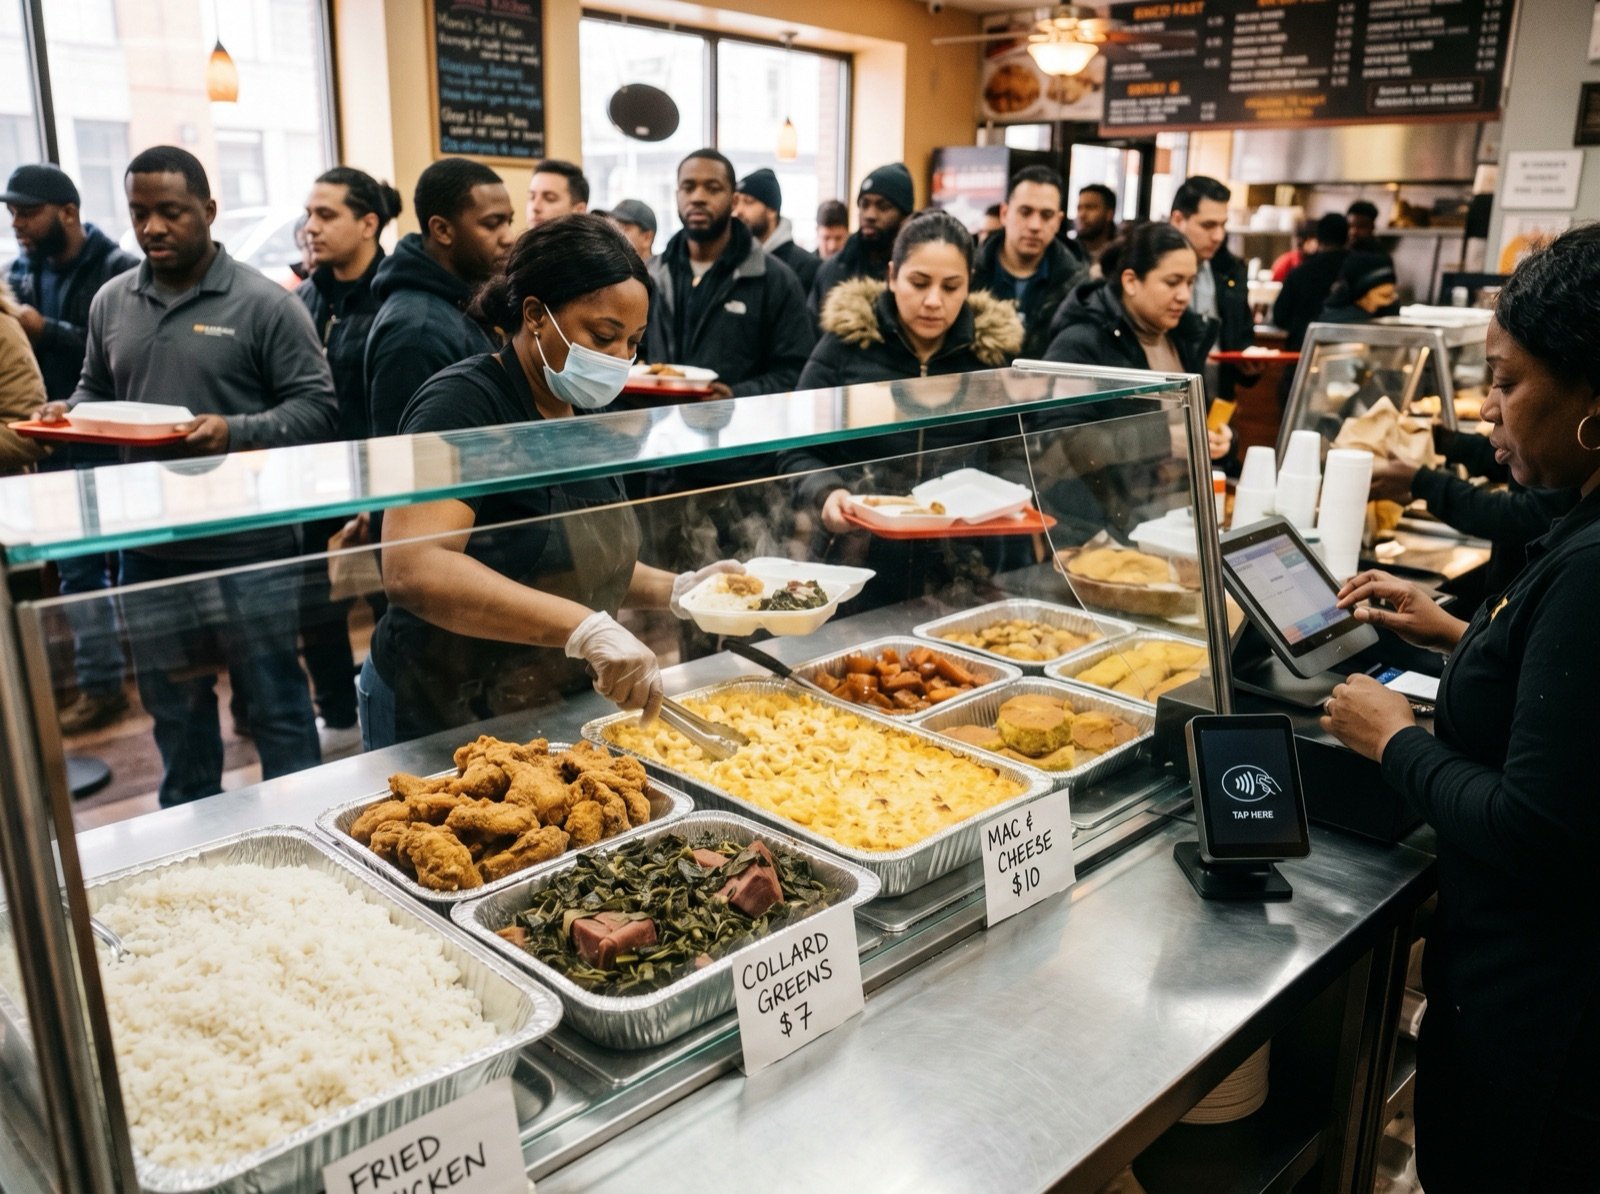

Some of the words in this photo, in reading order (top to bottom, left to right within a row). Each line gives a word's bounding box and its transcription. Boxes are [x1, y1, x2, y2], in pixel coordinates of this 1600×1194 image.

[988, 818, 1021, 851] MAC
[1232, 811, 1249, 819] TAP
[1251, 810, 1274, 819] HERE
[998, 829, 1053, 873] CHEESE
[1012, 867, 1040, 896] $10
[742, 933, 829, 989] COLLARD
[758, 959, 832, 1013] GREENS
[780, 1001, 812, 1037] $7
[349, 1136, 440, 1194] FRIED
